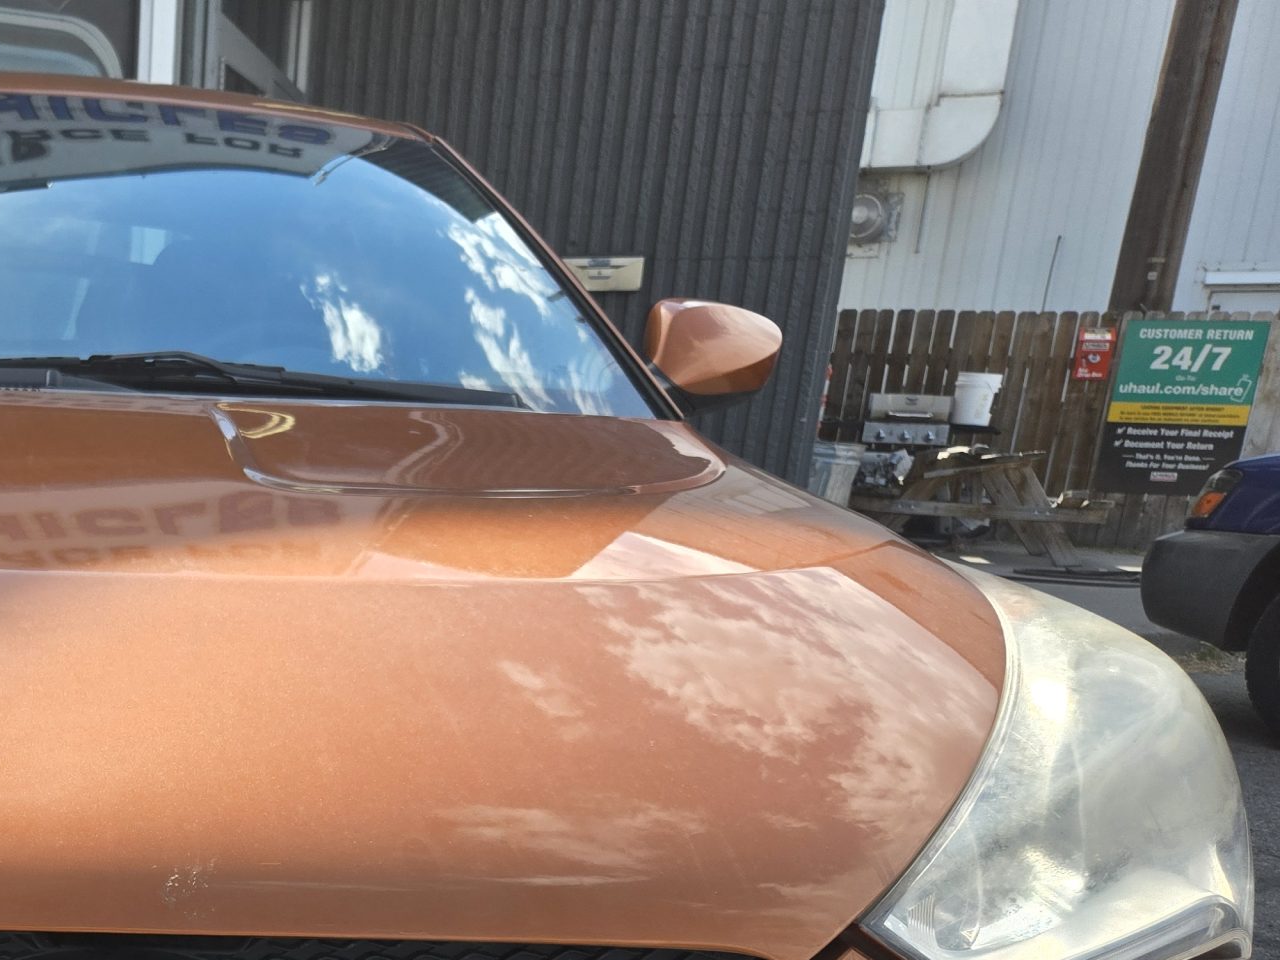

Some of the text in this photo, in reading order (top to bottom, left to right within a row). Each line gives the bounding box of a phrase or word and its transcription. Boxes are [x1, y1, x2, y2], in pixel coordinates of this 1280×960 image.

[1139, 328, 1254, 341] CUSTOMER RETURN
[1149, 343, 1232, 373] 24/7
[1119, 382, 1244, 397] uhaul.com/share
[1127, 427, 1234, 439] Receive Your Final Receipt
[1124, 440, 1214, 450] Document Your Return
